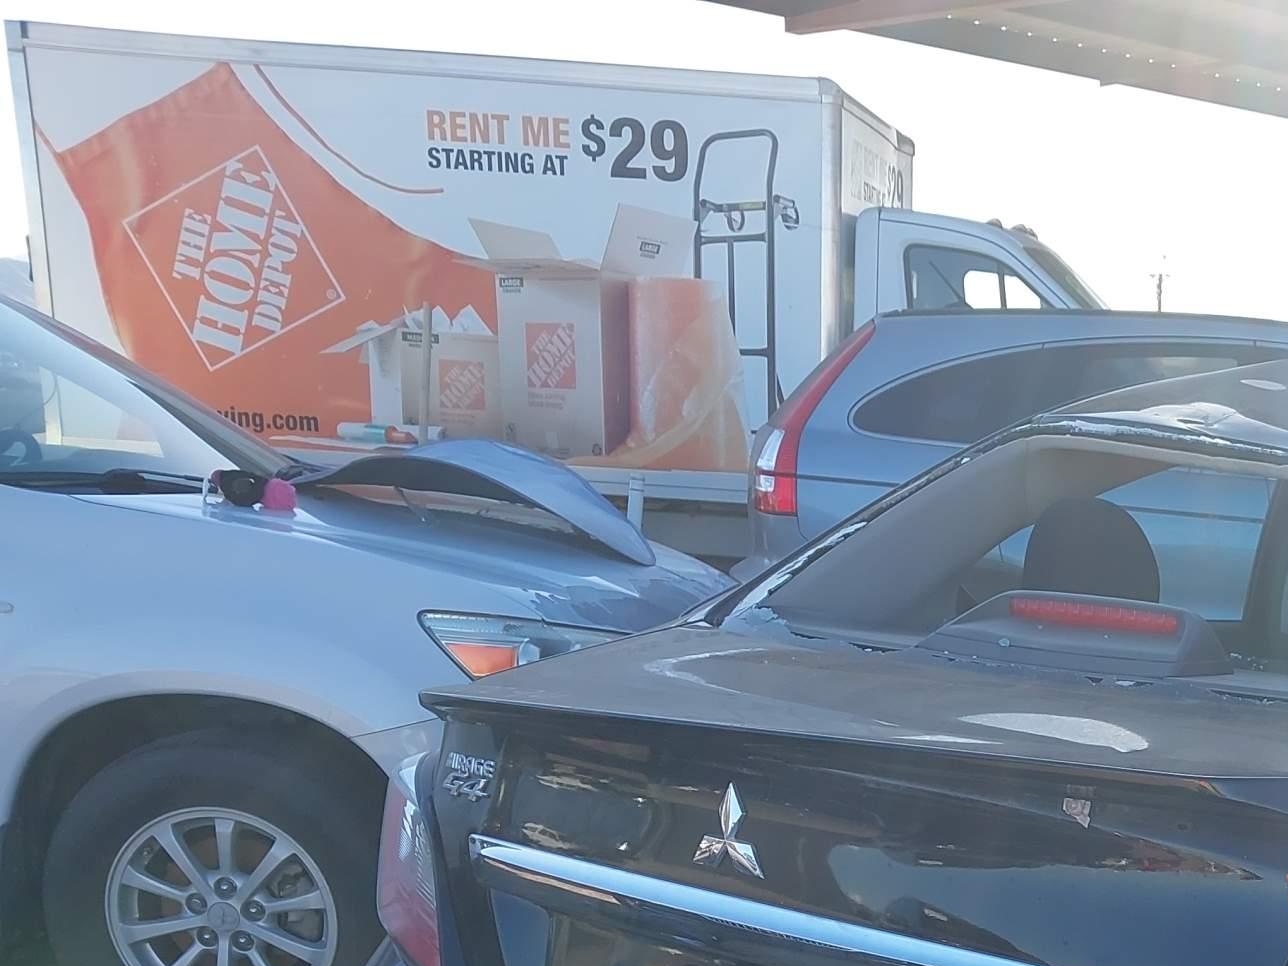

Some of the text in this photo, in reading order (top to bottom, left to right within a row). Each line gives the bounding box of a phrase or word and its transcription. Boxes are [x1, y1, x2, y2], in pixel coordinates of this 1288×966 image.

[426, 110, 571, 149] RENT ME
[427, 147, 568, 176] STARTING AT
[581, 114, 689, 182] $29
[172, 208, 211, 280] THE
[192, 160, 277, 356] HOME
[252, 209, 301, 333] DEPOT
